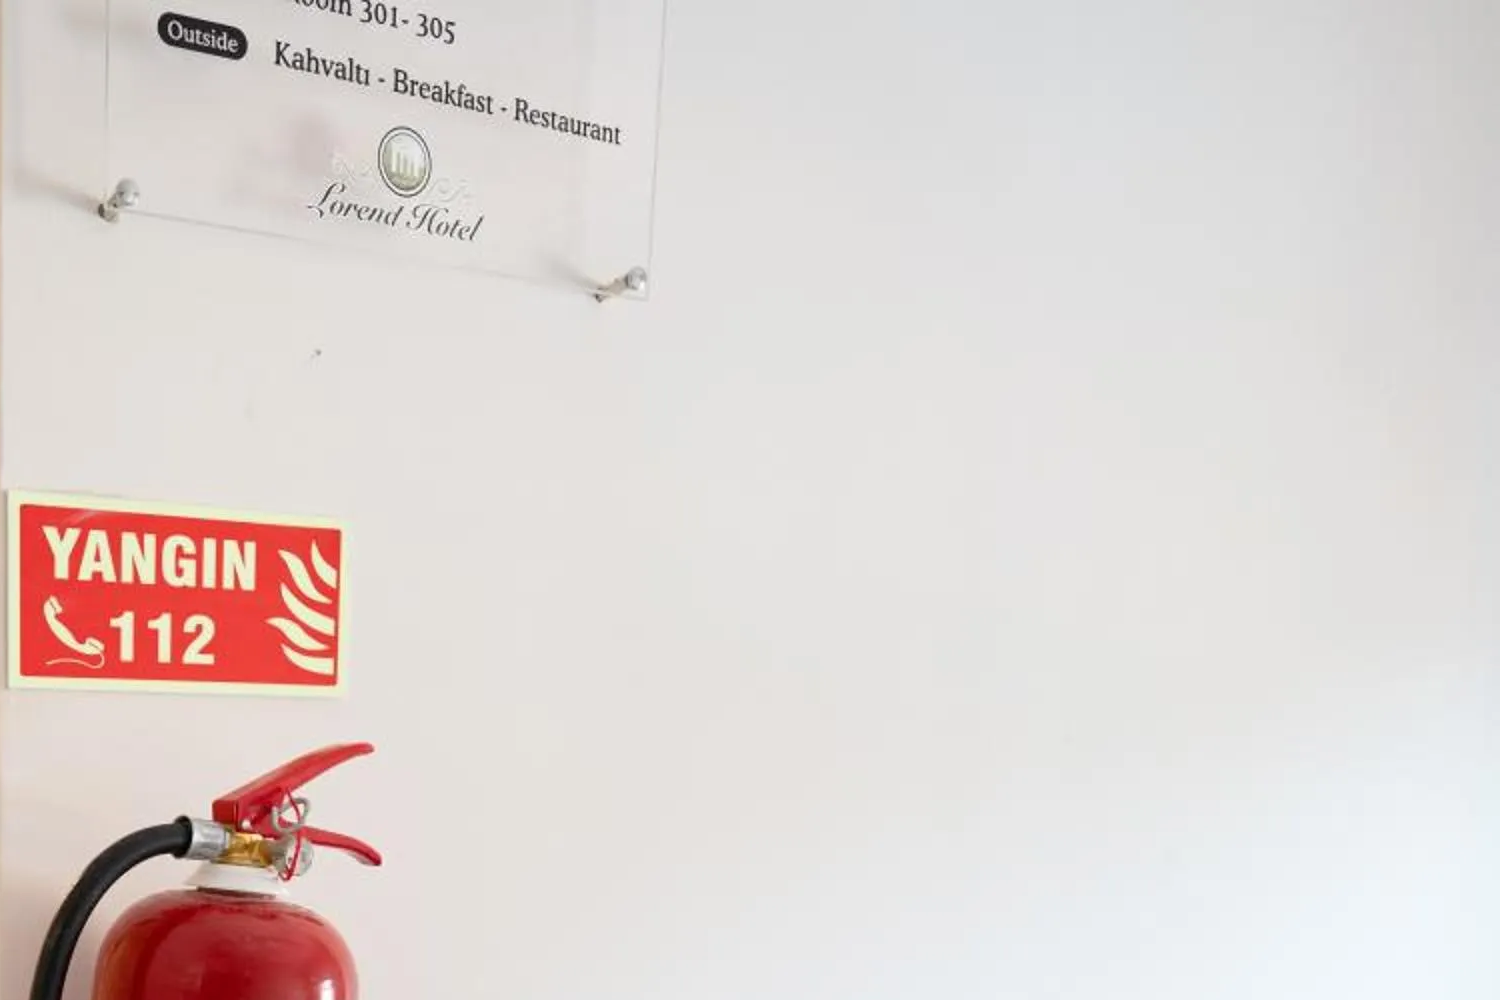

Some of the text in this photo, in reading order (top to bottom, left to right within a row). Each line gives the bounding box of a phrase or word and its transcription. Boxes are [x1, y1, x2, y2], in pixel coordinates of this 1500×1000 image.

[166, 20, 239, 54] Outside
[295, 0, 352, 17] om
[416, 12, 457, 45] 305
[274, 41, 370, 86] Kahvaltı
[393, 69, 494, 116] Breakfast
[514, 98, 622, 145] Restaurant
[307, 182, 485, 241] Lorend Hotel
[42, 525, 257, 591] YANGIN
[109, 610, 216, 665] 112
